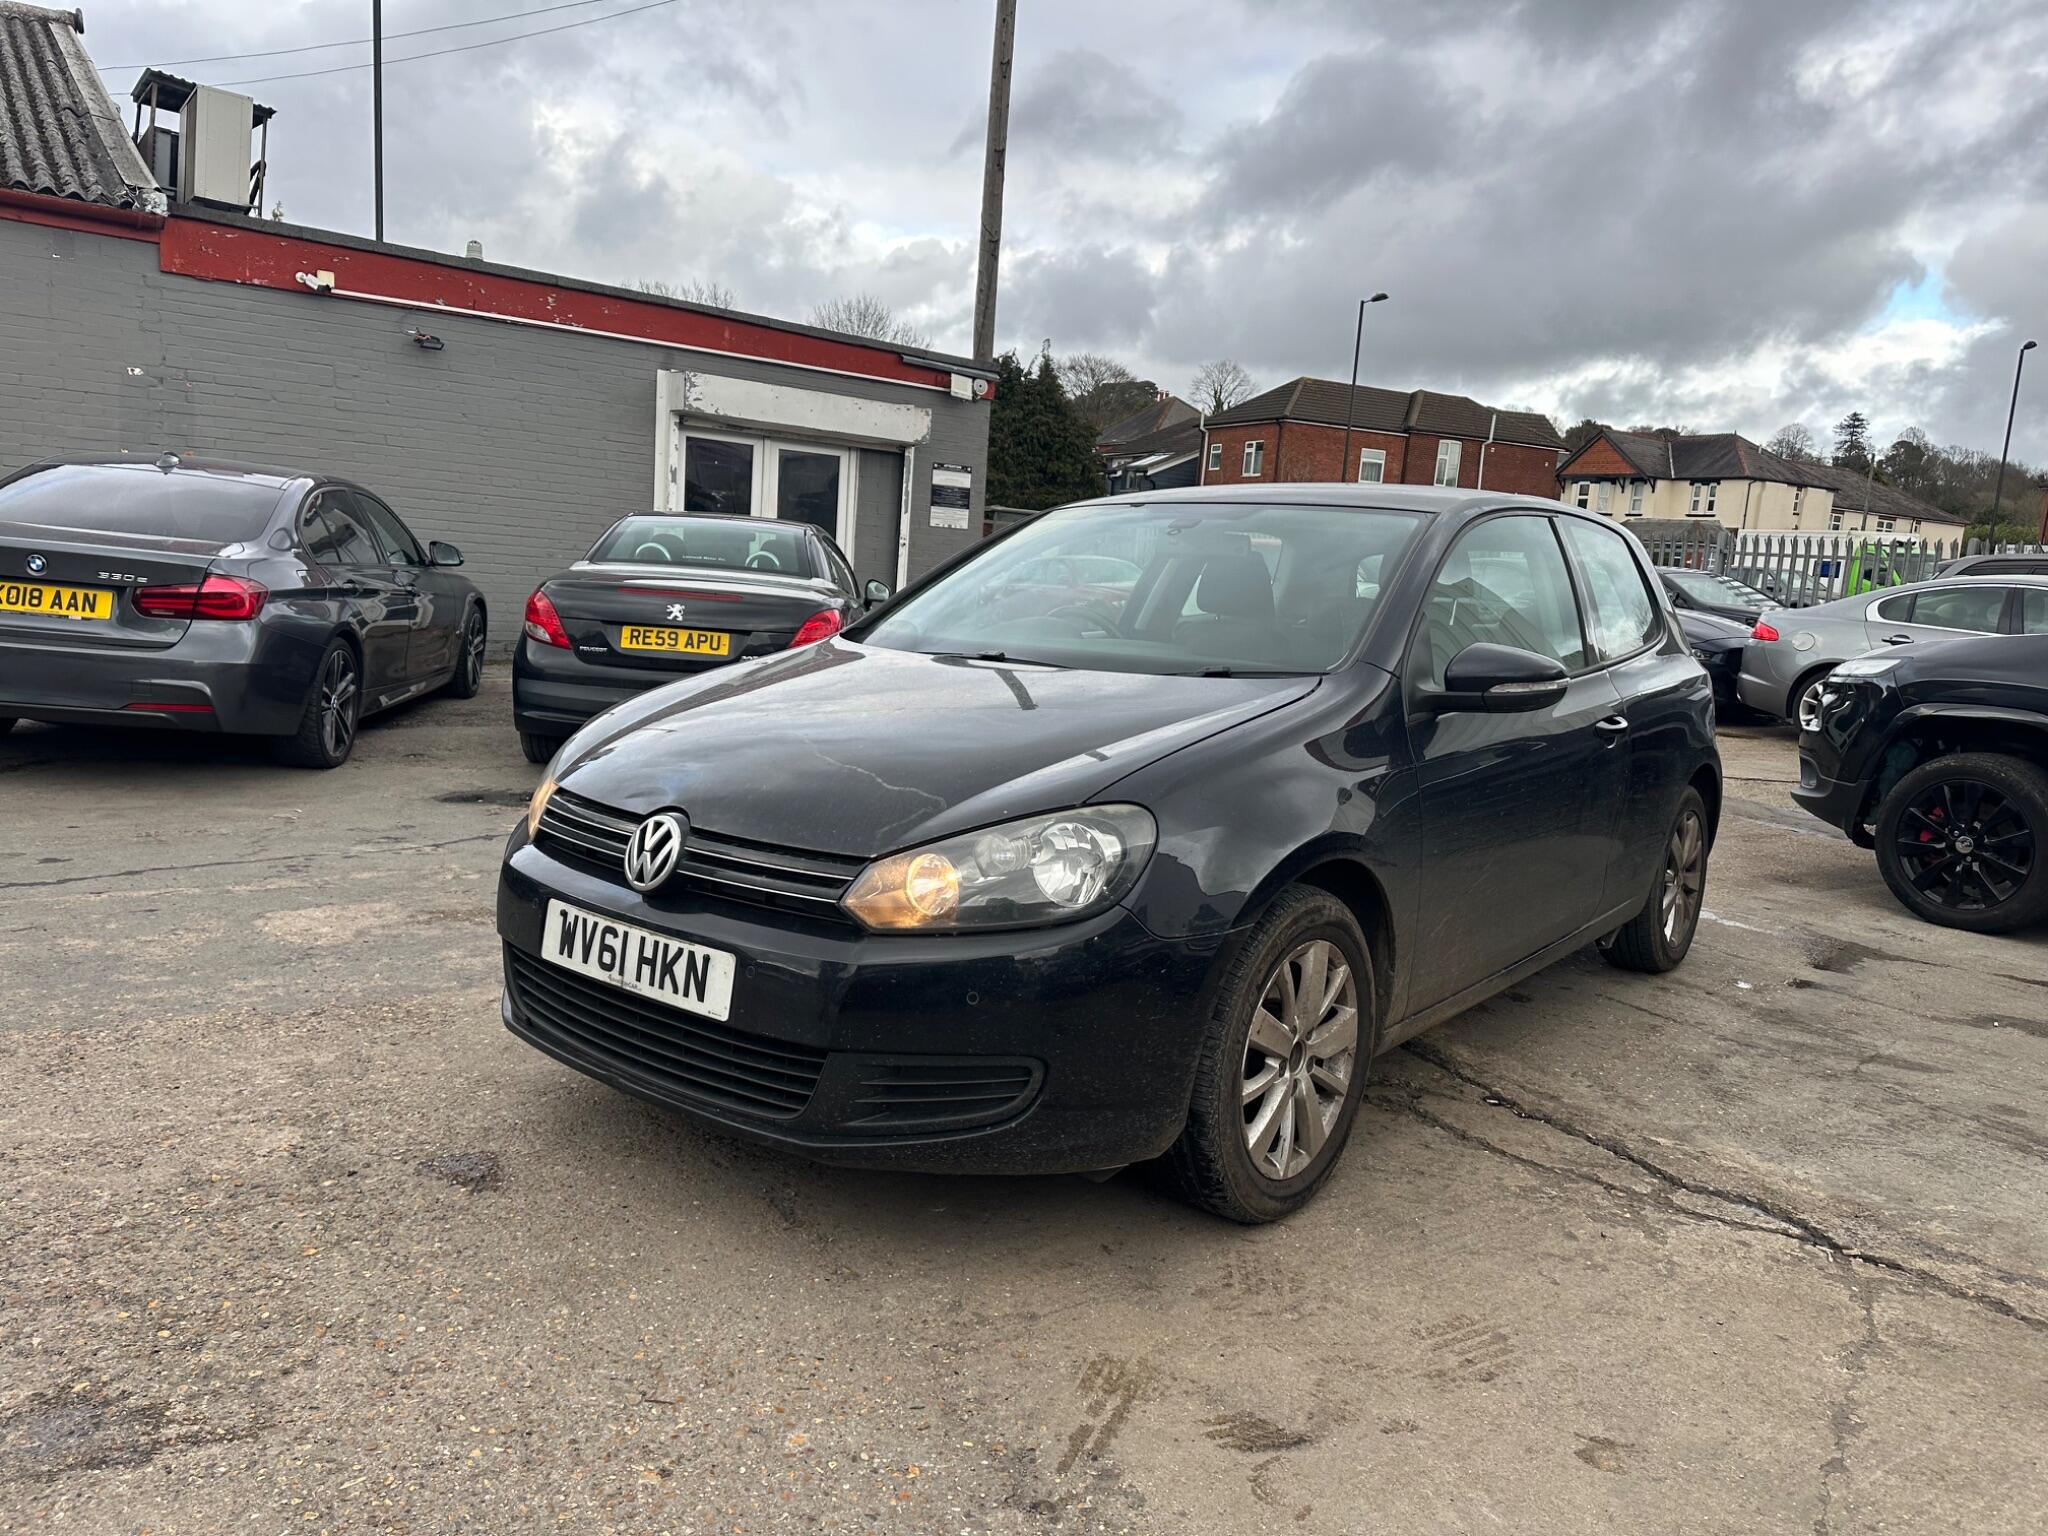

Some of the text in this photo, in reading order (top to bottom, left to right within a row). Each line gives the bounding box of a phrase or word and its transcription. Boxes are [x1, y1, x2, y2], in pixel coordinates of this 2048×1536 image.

[50, 590, 97, 613] AAN
[629, 628, 721, 651] RE59 APU
[559, 909, 711, 1003] WV61 HKN
